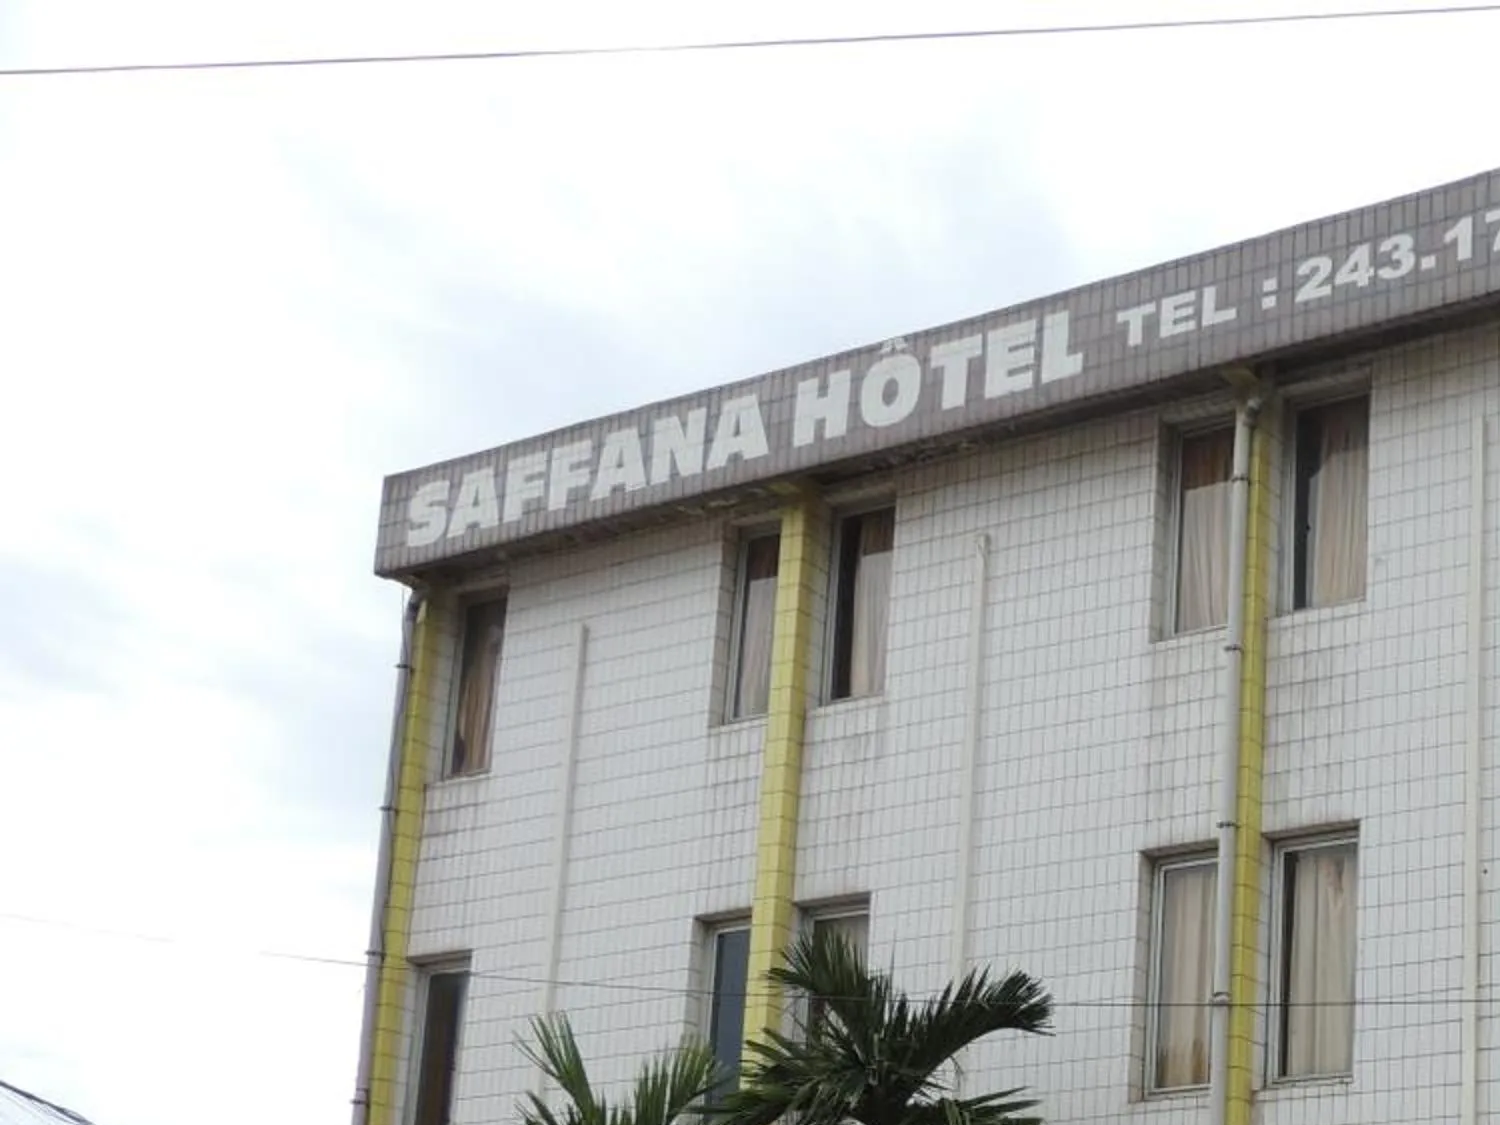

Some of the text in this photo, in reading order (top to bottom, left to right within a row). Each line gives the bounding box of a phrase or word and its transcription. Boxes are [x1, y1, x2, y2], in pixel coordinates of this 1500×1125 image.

[406, 394, 768, 548] SAFFANA
[794, 310, 1084, 449] HÔTEL
[1116, 284, 1238, 348] TEL
